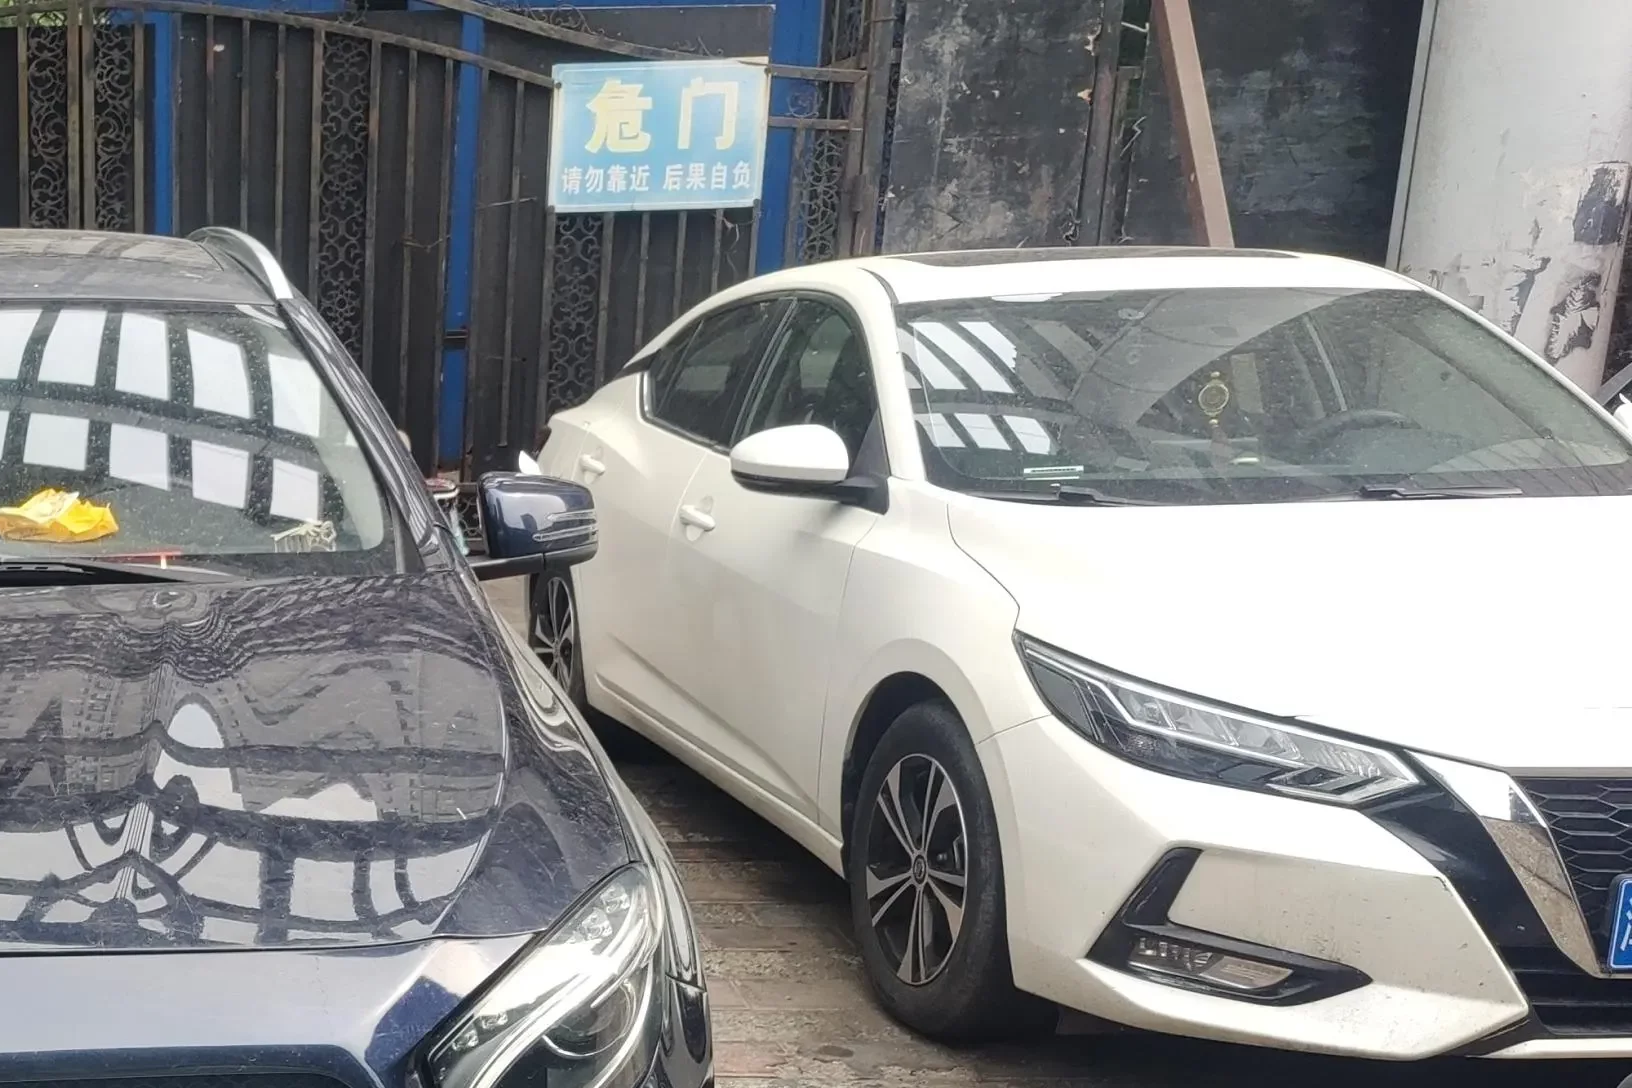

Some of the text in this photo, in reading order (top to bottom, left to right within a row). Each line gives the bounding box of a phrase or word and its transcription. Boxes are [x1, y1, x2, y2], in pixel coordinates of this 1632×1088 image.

[584, 76, 739, 154] 危门
[561, 160, 753, 195] 请勿靠近 后果自负
